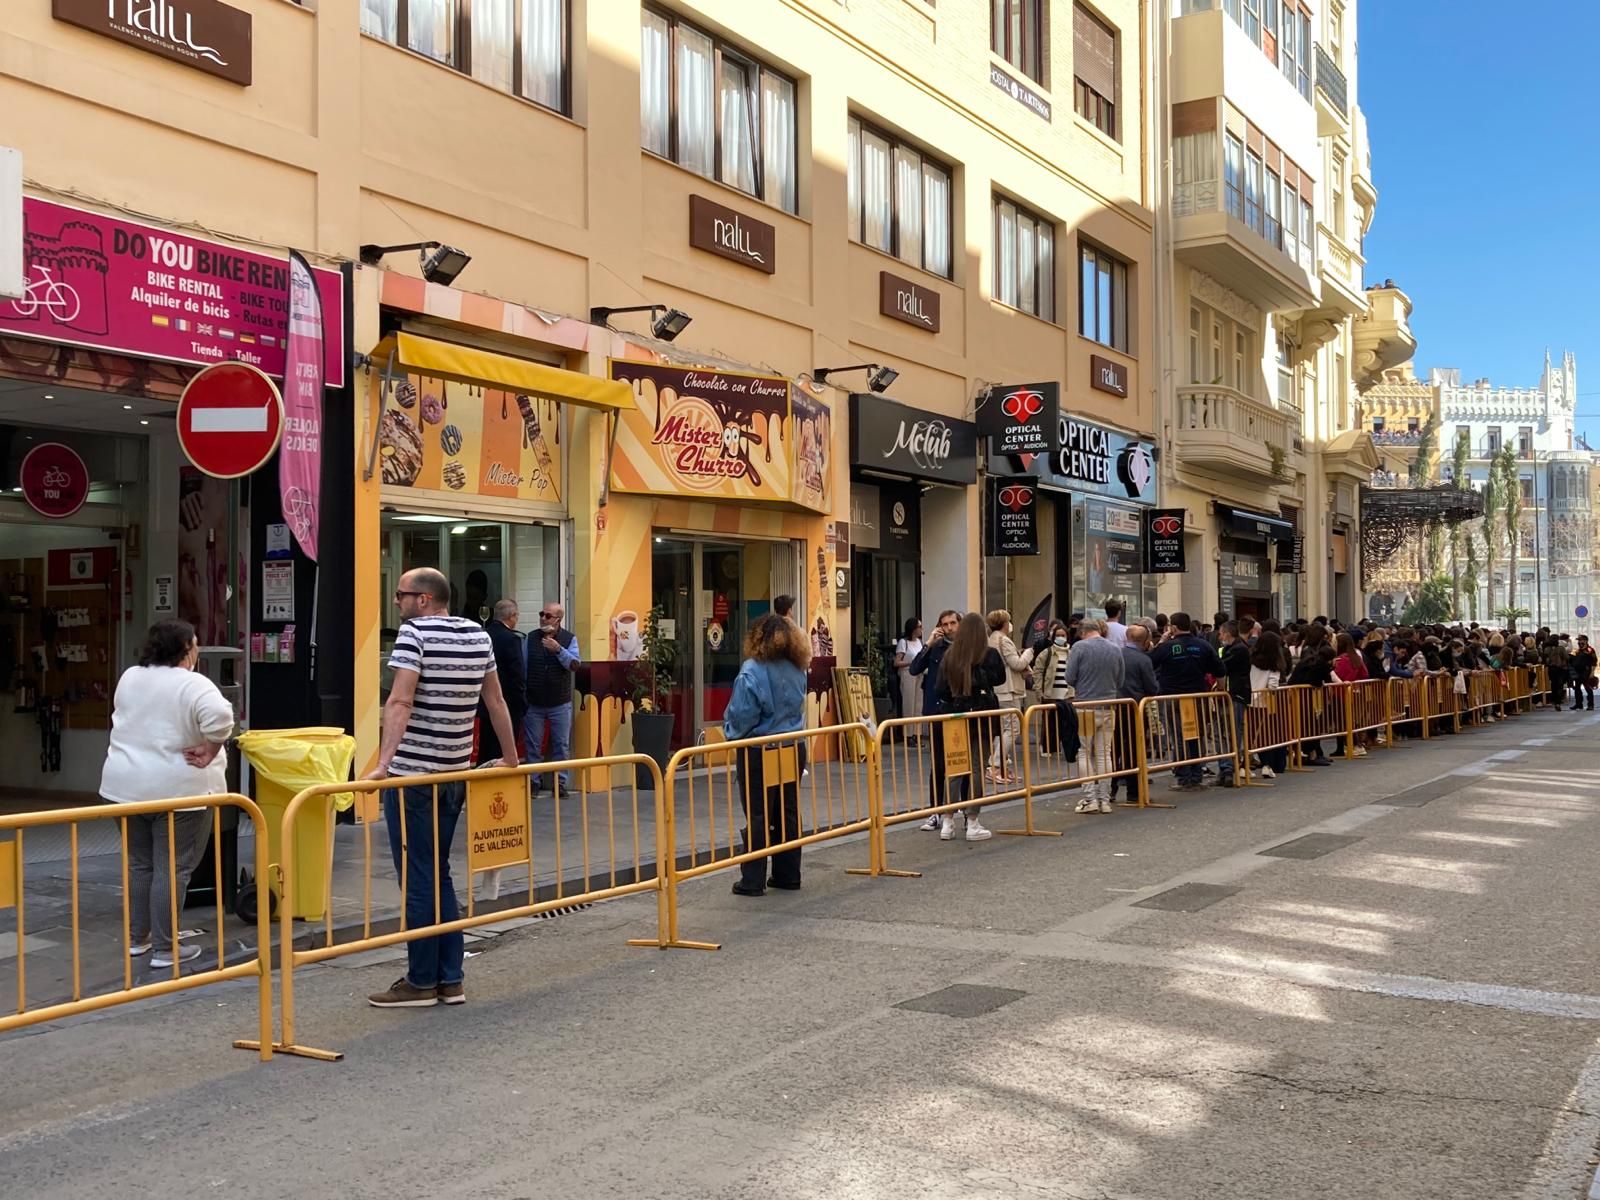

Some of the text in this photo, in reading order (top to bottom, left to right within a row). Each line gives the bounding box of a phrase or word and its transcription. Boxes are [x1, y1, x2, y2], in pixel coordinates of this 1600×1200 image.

[109, 22, 199, 59] VALENCIA BOUTIQUE ROOMS
[714, 215, 762, 260] nalu
[113, 227, 289, 293] DO YOU BIKE REN
[147, 270, 224, 299] BIKE RENTAL
[131, 286, 230, 318] Alquiler de bicis
[240, 291, 264, 309] BIKE
[897, 285, 931, 323] nalu
[243, 310, 274, 328] Rutas
[191, 342, 262, 364] Tienda Taller
[683, 372, 786, 397] Chocolate con Churros
[653, 416, 720, 446] Mister
[1005, 425, 1042, 435] OPTICAL
[1005, 434, 1042, 444] CENTER
[1060, 418, 1113, 457] OPTICAL
[676, 445, 745, 476] Churro
[1060, 447, 1111, 483] CENTER
[44, 489, 60, 499] YOU
[485, 463, 548, 496] Mister Pop
[1001, 513, 1030, 521] OPTICAL
[474, 825, 523, 841] AJUNTAMENT
[474, 838, 523, 853] DE VALÈNCIA
